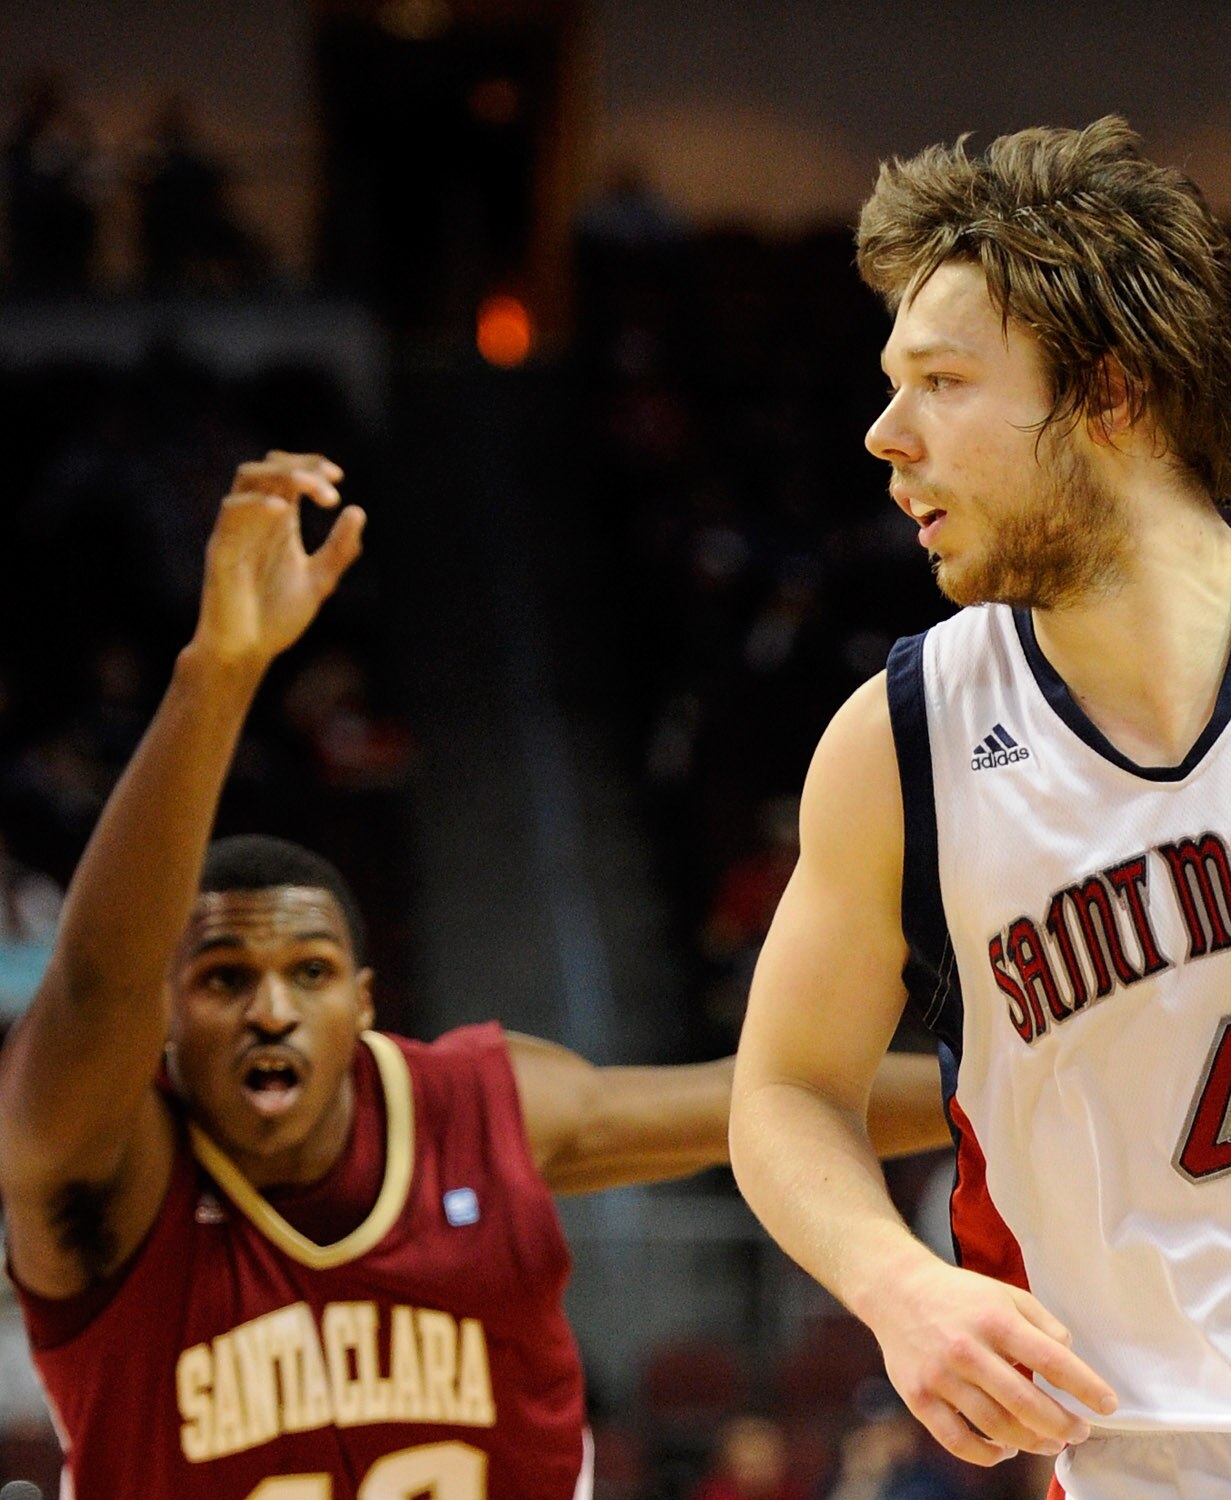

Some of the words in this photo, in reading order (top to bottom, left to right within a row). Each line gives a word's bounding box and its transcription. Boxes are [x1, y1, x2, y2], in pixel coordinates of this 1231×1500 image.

[971, 748, 1030, 771] adidas
[986, 854, 1175, 1046] SAINT
[175, 1301, 334, 1464] SANTA
[322, 1301, 497, 1429] CLARA
